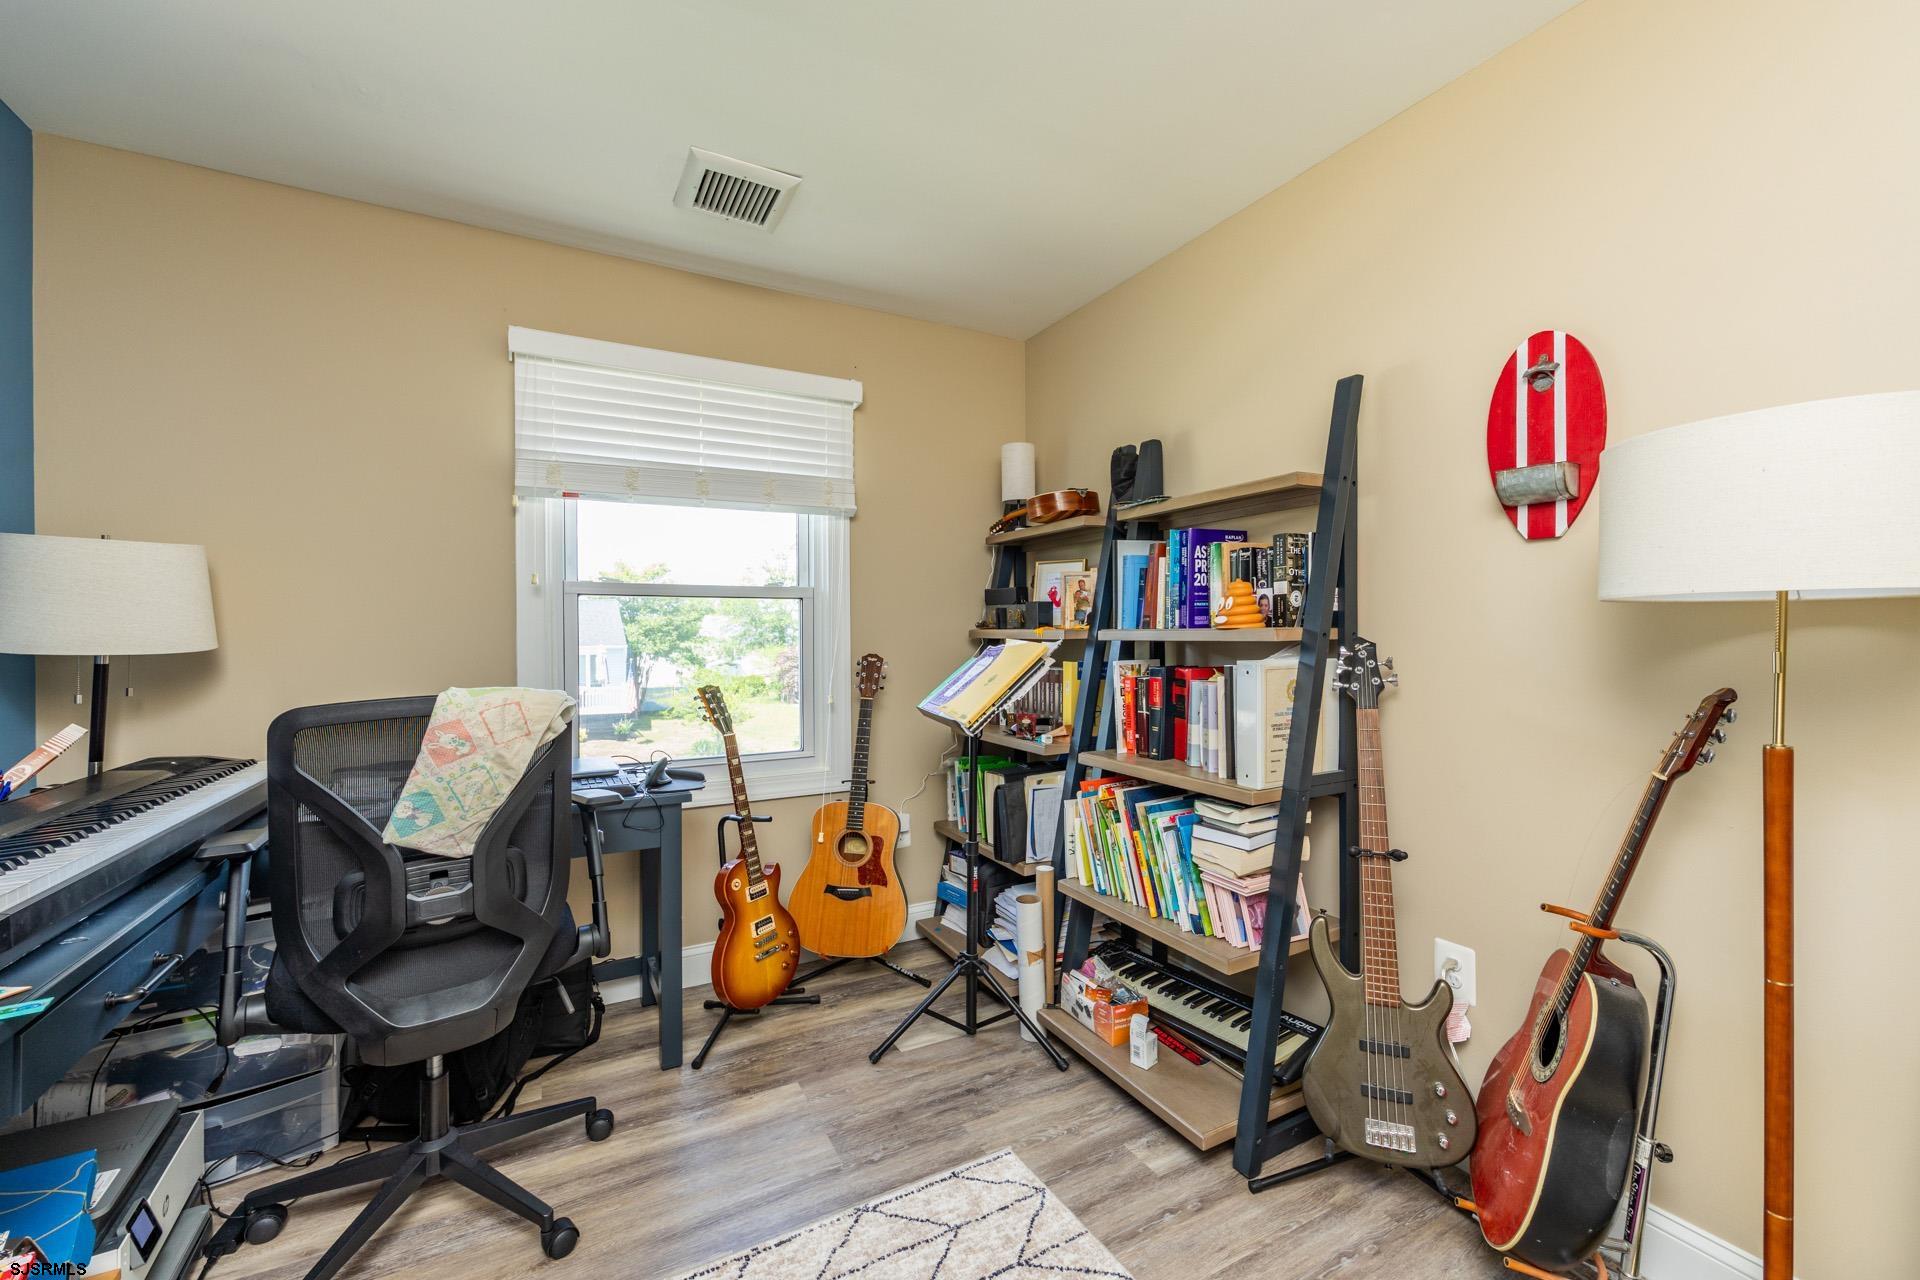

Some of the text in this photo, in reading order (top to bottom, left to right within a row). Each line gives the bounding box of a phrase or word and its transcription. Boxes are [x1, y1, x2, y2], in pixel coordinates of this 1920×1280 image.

[1289, 546, 1302, 555] THE
[1194, 573, 1209, 587] 20
[1280, 1014, 1318, 1033] AUDIO
